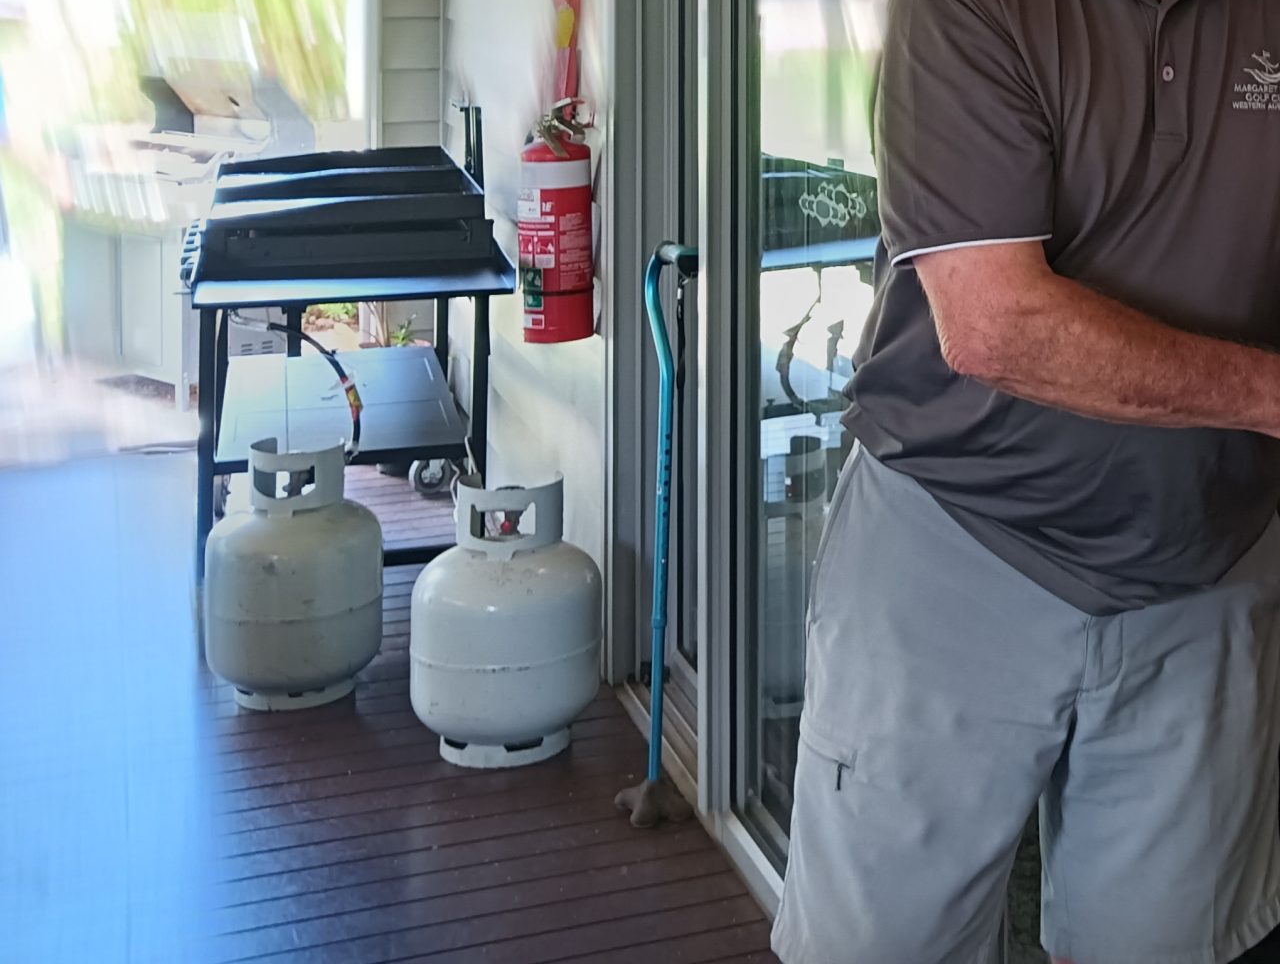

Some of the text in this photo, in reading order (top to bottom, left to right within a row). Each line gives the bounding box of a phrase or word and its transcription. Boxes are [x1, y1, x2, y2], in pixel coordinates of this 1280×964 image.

[1234, 83, 1278, 93] MARGARET
[1245, 92, 1270, 102] GOLF
[1232, 101, 1266, 110] WESTERN
